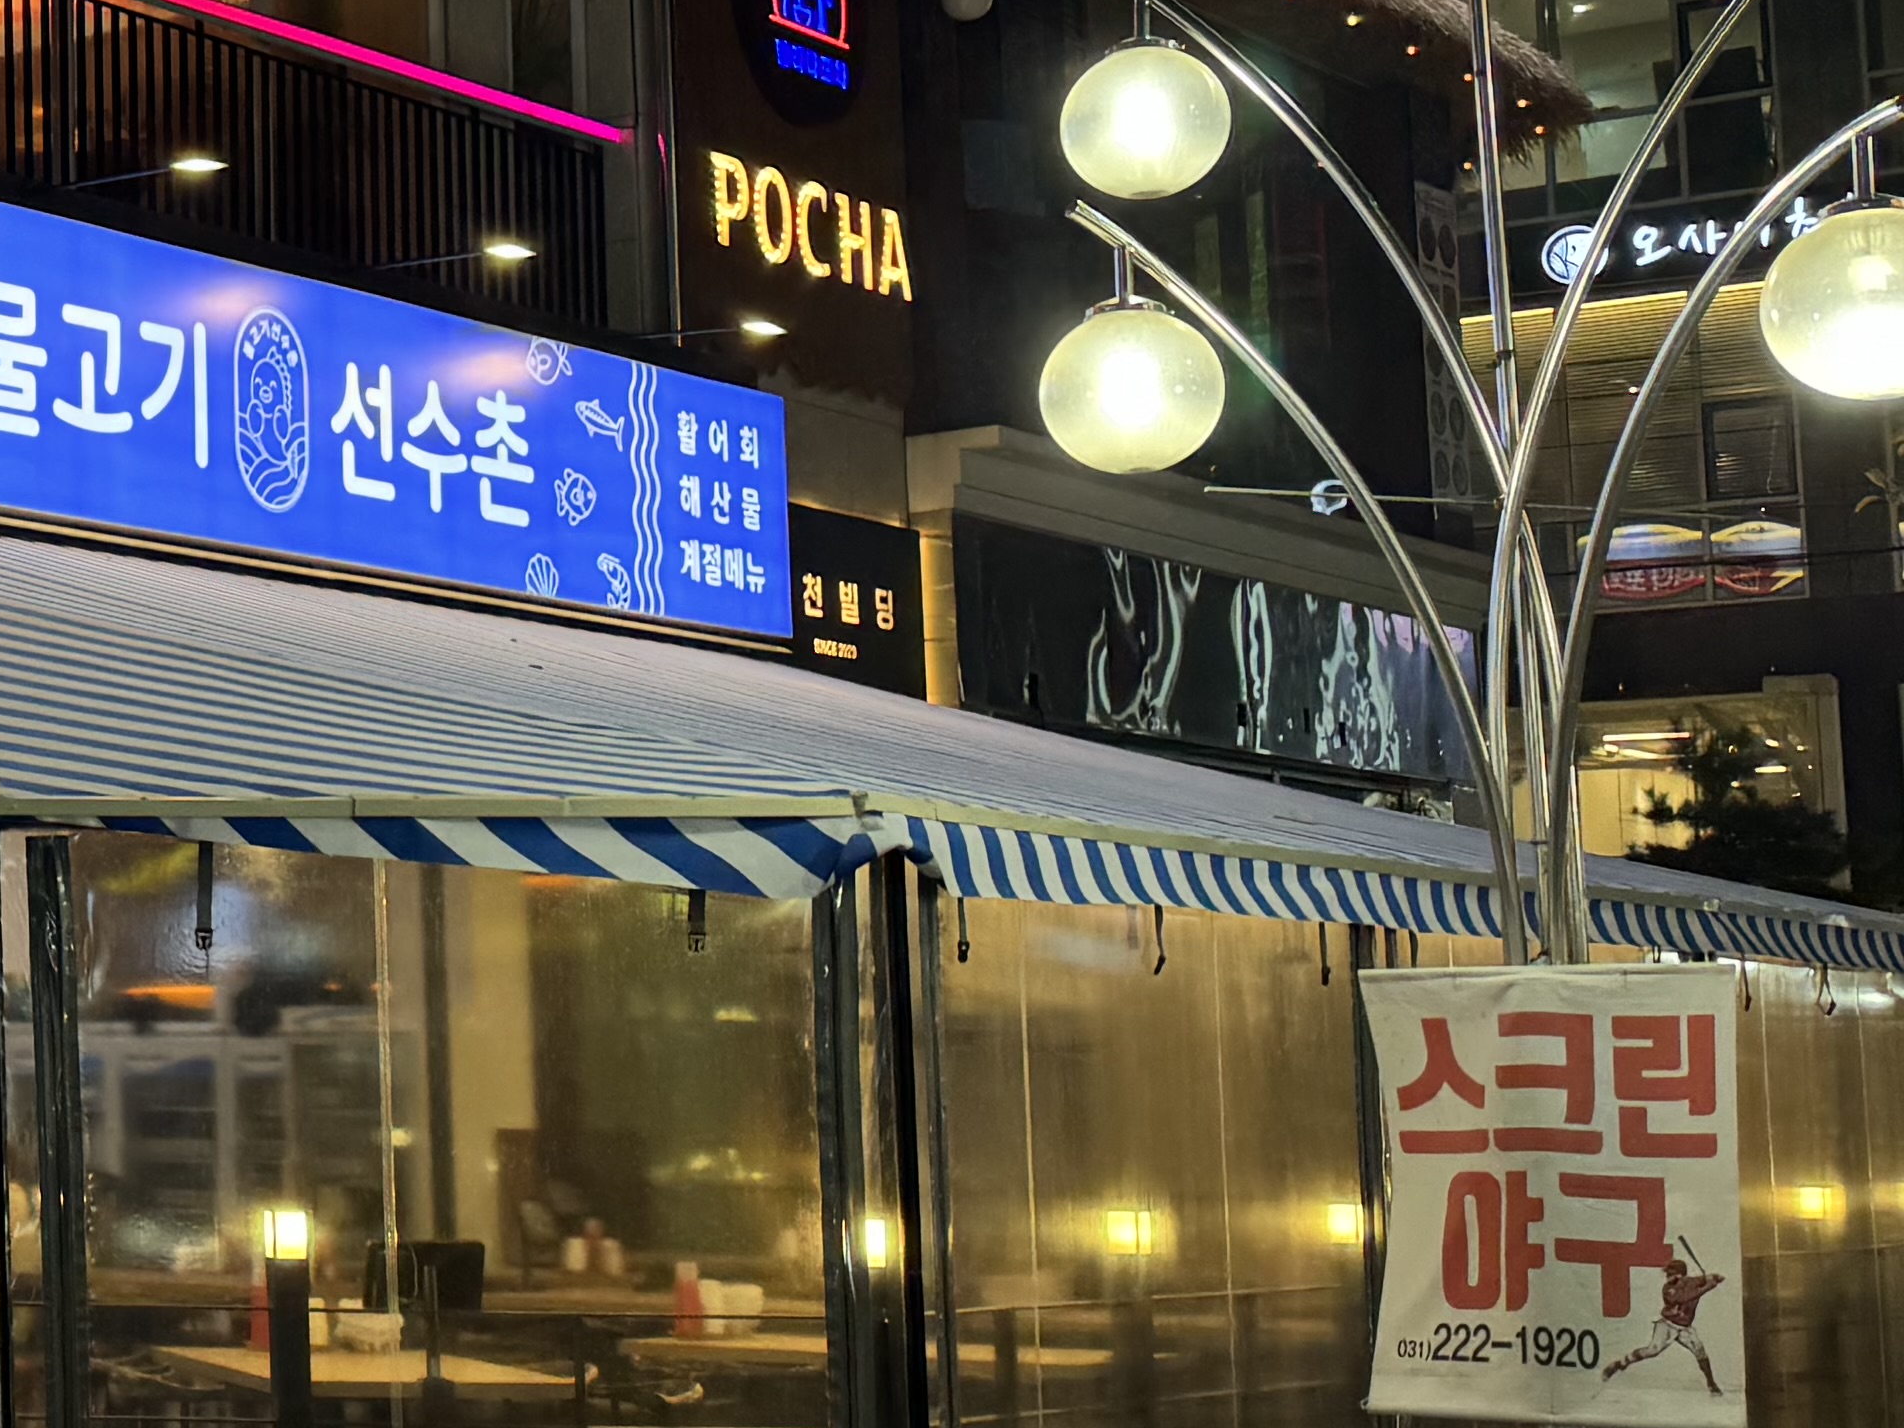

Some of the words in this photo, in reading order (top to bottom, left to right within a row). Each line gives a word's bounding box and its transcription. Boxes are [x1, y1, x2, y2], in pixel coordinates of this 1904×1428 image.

[711, 151, 912, 302] POCHA
[330, 362, 535, 529] 선수촌
[677, 410, 760, 470] 활어회
[678, 475, 762, 532] 해산물
[678, 538, 766, 595] 계절메뉴
[1397, 1011, 1718, 1158] 스크린
[1441, 1170, 1675, 1318] 야구
